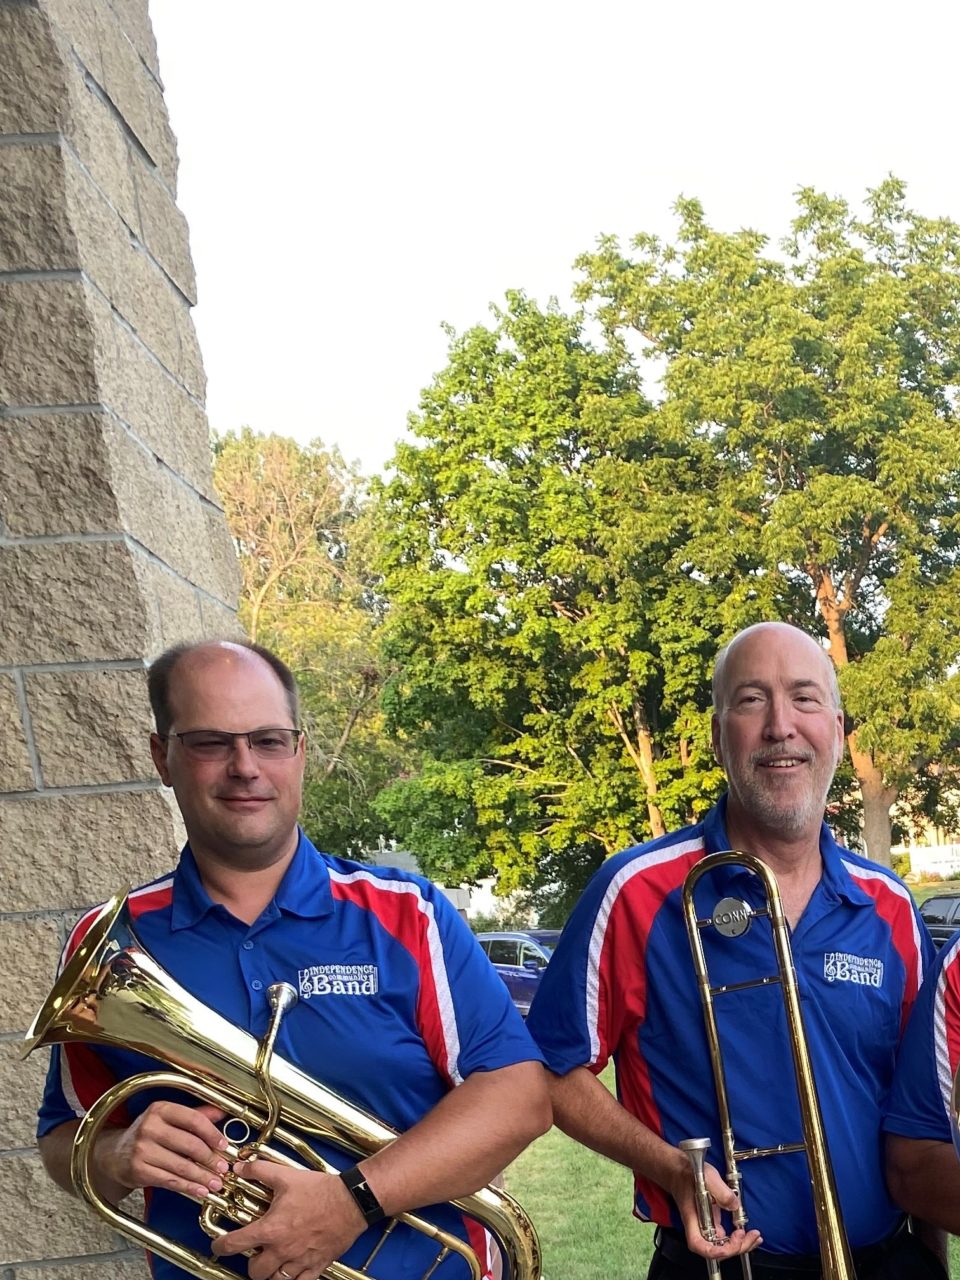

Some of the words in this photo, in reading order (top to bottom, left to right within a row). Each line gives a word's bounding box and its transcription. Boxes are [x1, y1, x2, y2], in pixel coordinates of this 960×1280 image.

[715, 909, 748, 926] CONN
[309, 964, 374, 976] INDEPENDENCE
[835, 961, 882, 988] Band
[311, 973, 375, 995] Band
